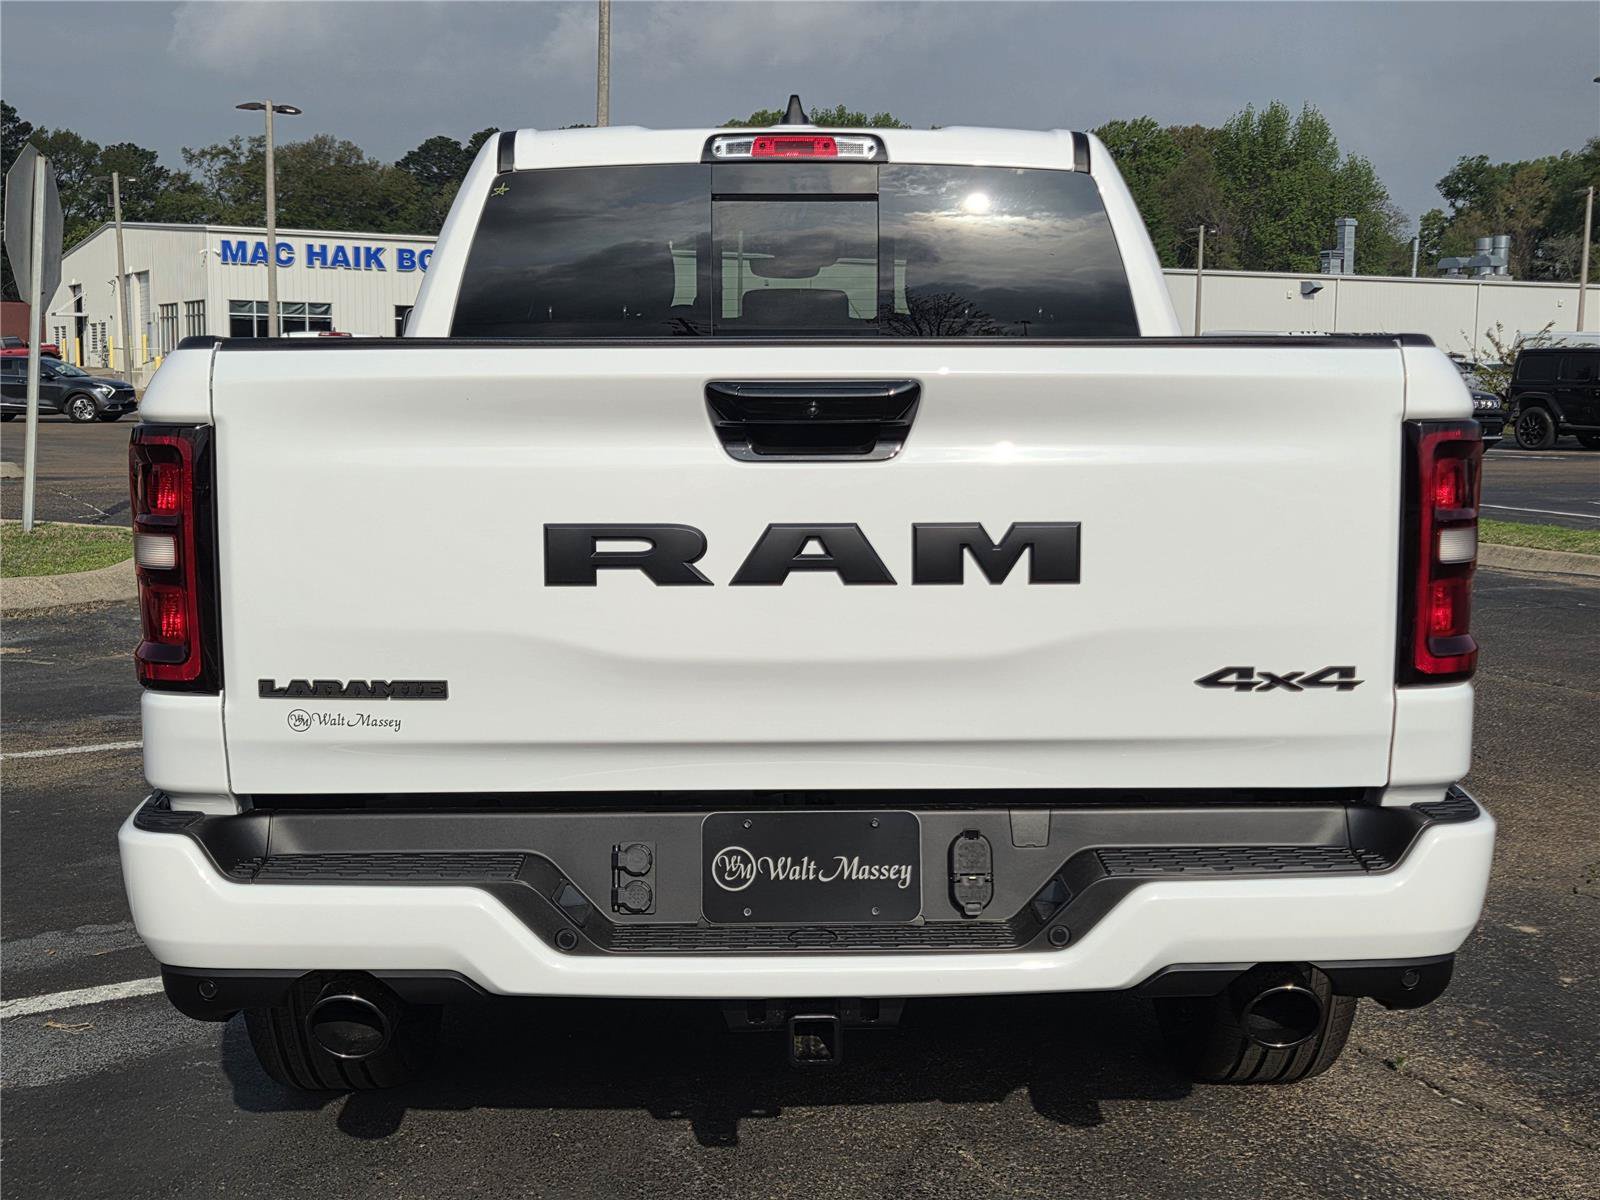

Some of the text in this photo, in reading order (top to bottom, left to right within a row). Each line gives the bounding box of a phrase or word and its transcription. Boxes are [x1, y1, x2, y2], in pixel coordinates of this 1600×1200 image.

[221, 240, 296, 266] MAC
[306, 243, 387, 271] HAIK
[544, 521, 1082, 587] RAM
[258, 679, 449, 700] LARAMIE
[1194, 665, 1365, 692] 4x4
[311, 712, 345, 726] Walt
[346, 713, 402, 732] Massey
[757, 856, 817, 880] Walt
[818, 856, 913, 889] Massey
